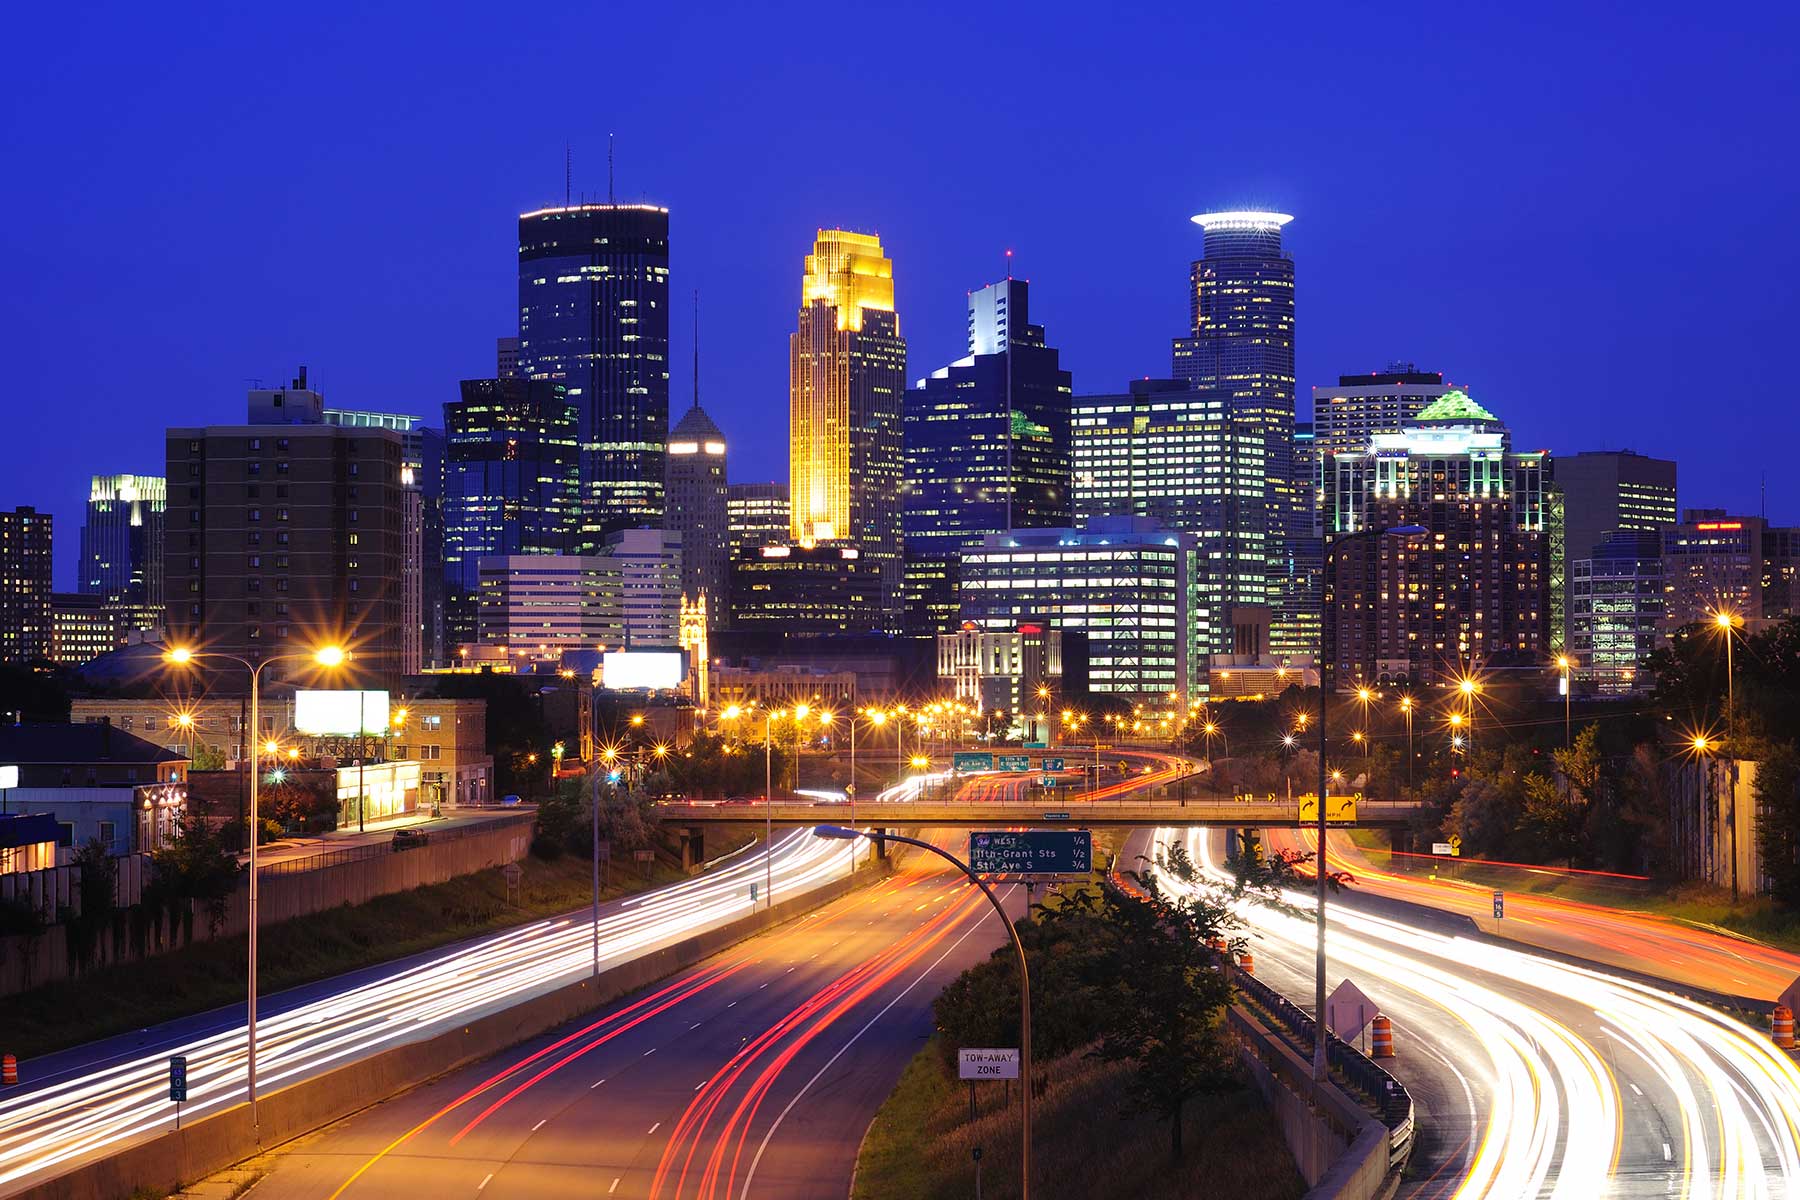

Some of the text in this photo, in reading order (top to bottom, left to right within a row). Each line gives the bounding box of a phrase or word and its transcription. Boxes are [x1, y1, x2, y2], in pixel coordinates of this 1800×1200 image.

[976, 849, 1085, 858] 11th-Grant Sts 1/2
[976, 861, 1085, 870] 5th Ave S 3/4
[965, 1054, 1013, 1062] TOW-AWAY
[977, 1066, 1001, 1074] ZONE
[175, 1078, 181, 1087] 0
[175, 1091, 181, 1099] 3
